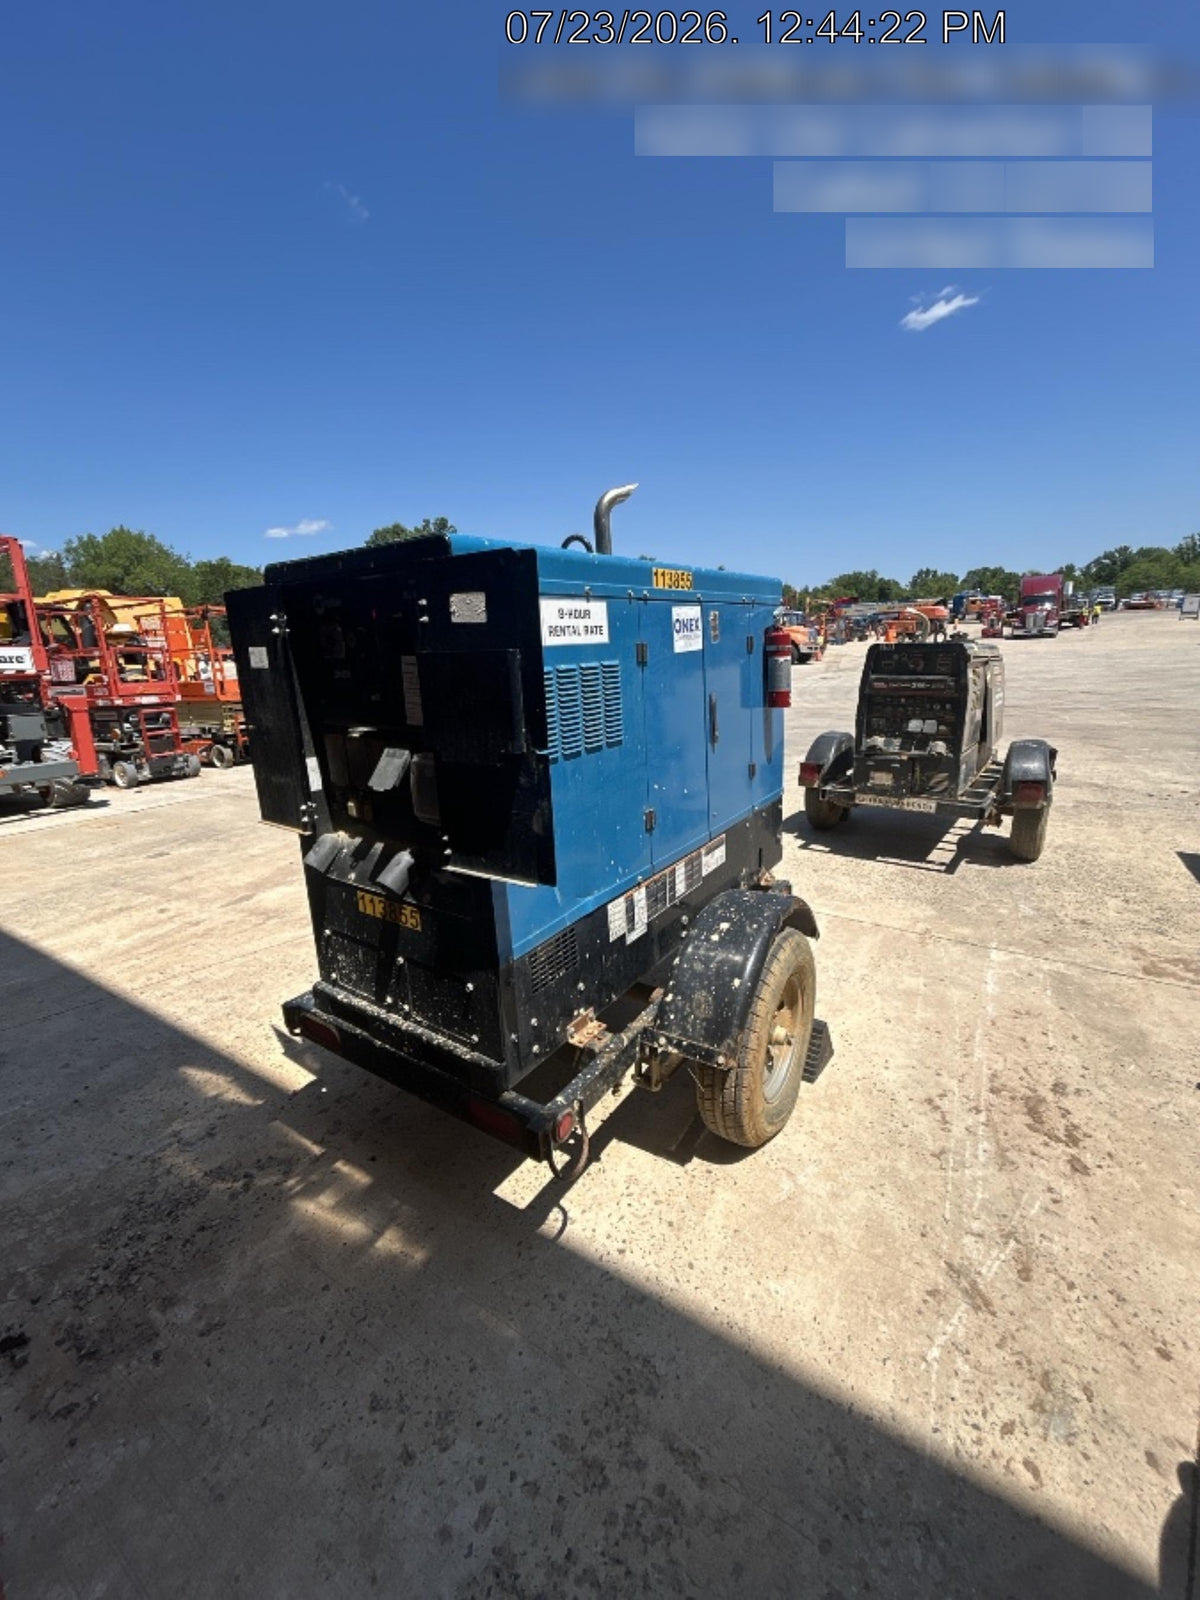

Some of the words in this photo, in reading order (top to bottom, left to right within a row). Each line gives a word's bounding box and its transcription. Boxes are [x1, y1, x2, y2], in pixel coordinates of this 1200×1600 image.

[654, 568, 692, 590] 113855
[548, 625, 581, 637] RENTAL
[583, 624, 604, 637] RATE
